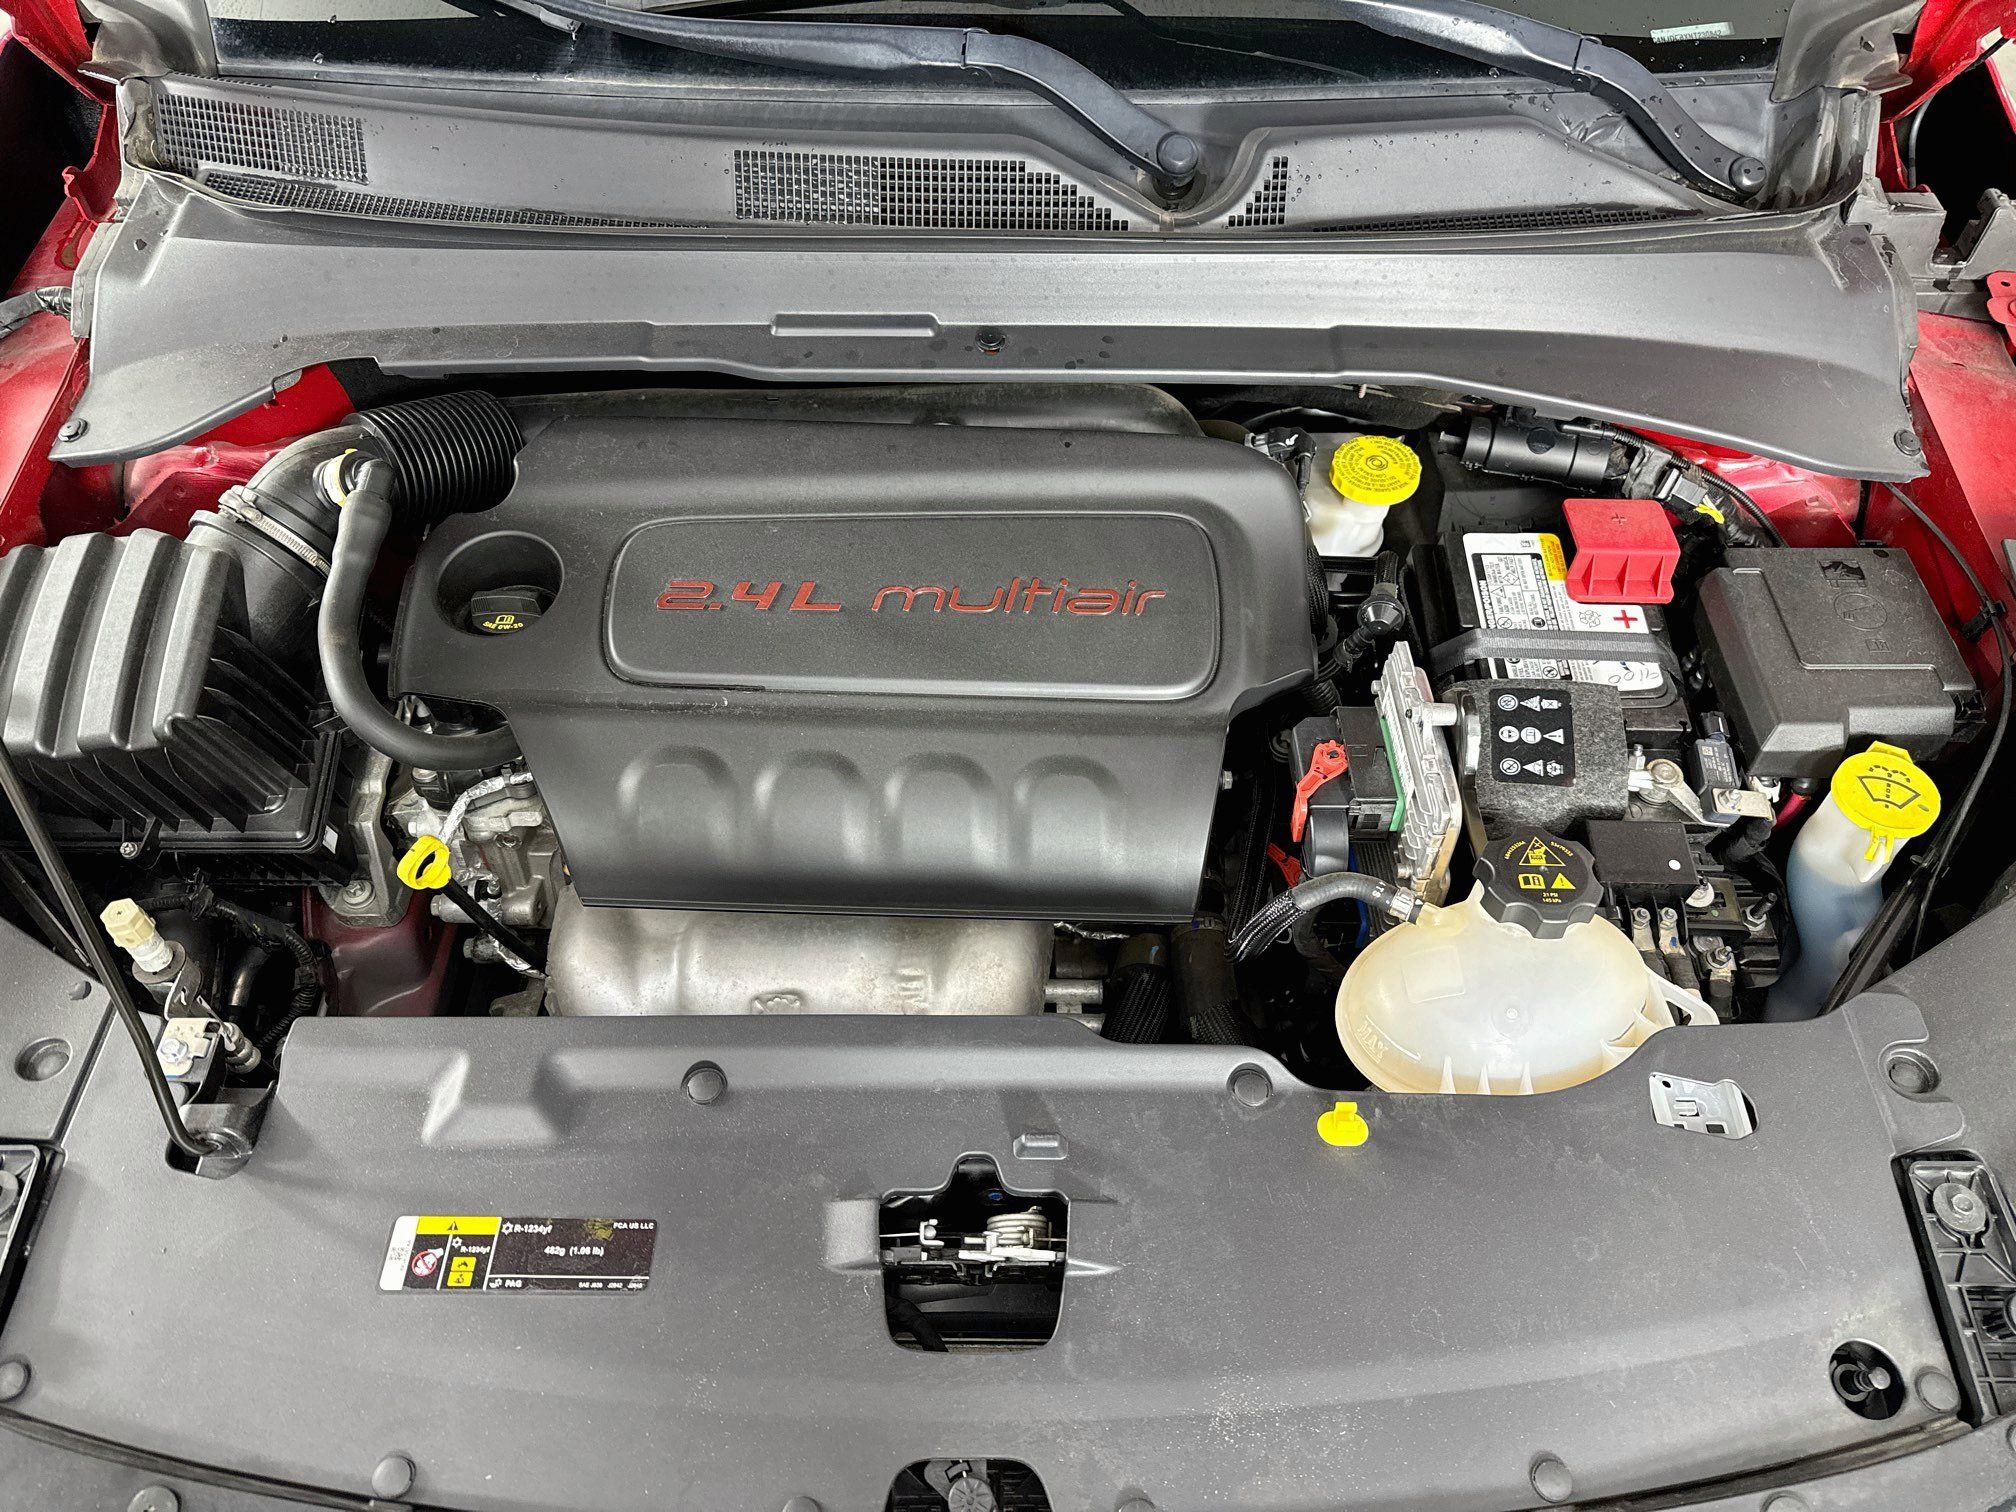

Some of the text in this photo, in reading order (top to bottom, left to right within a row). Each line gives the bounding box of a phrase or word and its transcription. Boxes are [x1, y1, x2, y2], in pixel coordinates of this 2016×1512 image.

[871, 577, 1167, 616] multiair
[482, 621, 497, 629] SAE
[514, 1223, 553, 1235] R-1234yf
[629, 1222, 639, 1230] US
[640, 1222, 654, 1230] LLC
